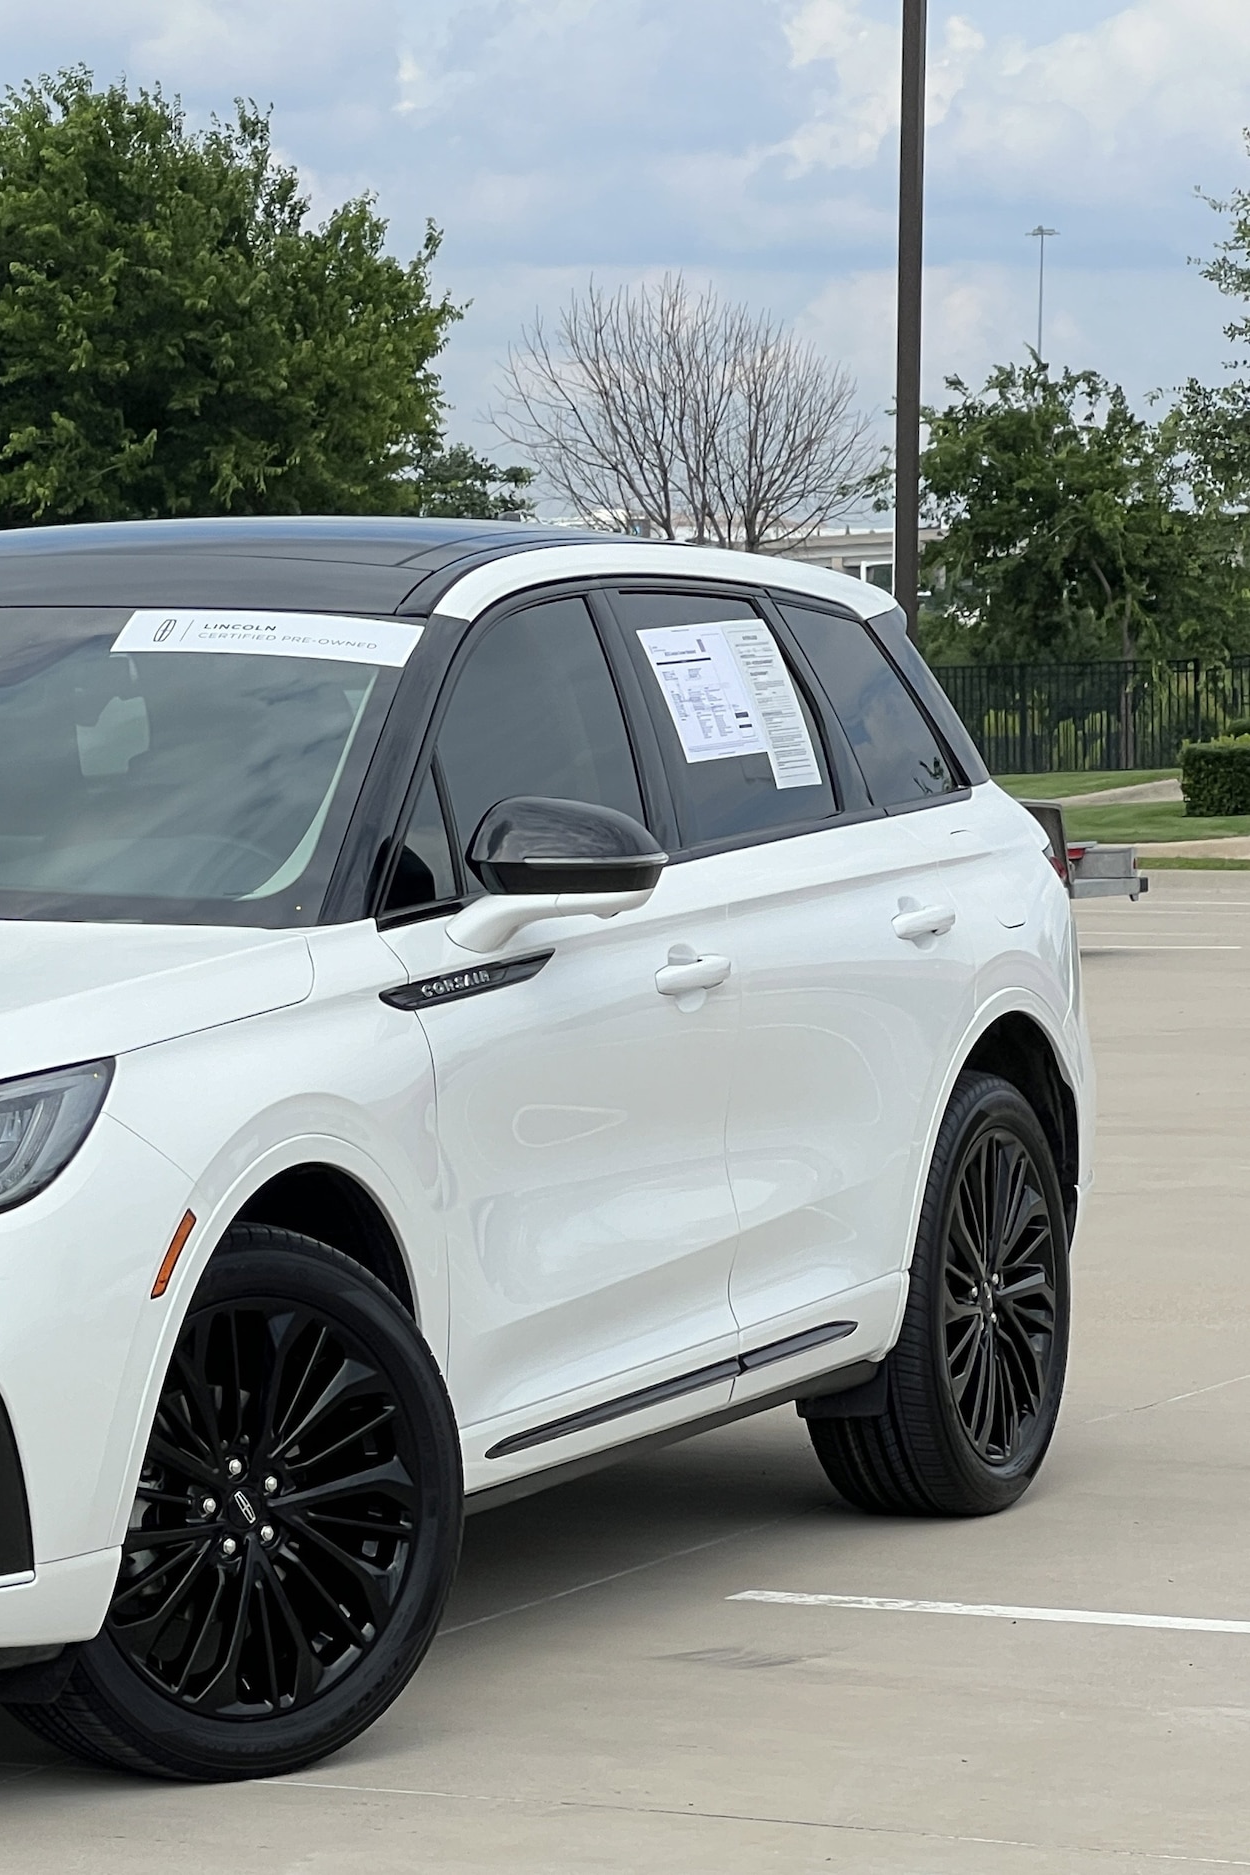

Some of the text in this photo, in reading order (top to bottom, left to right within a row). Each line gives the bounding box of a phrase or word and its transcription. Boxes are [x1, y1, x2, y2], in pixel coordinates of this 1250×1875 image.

[203, 622, 277, 632] LINCOLN
[197, 631, 378, 650] CERTIFIED PRE-OWNED
[420, 969, 491, 998] CORSAIR
